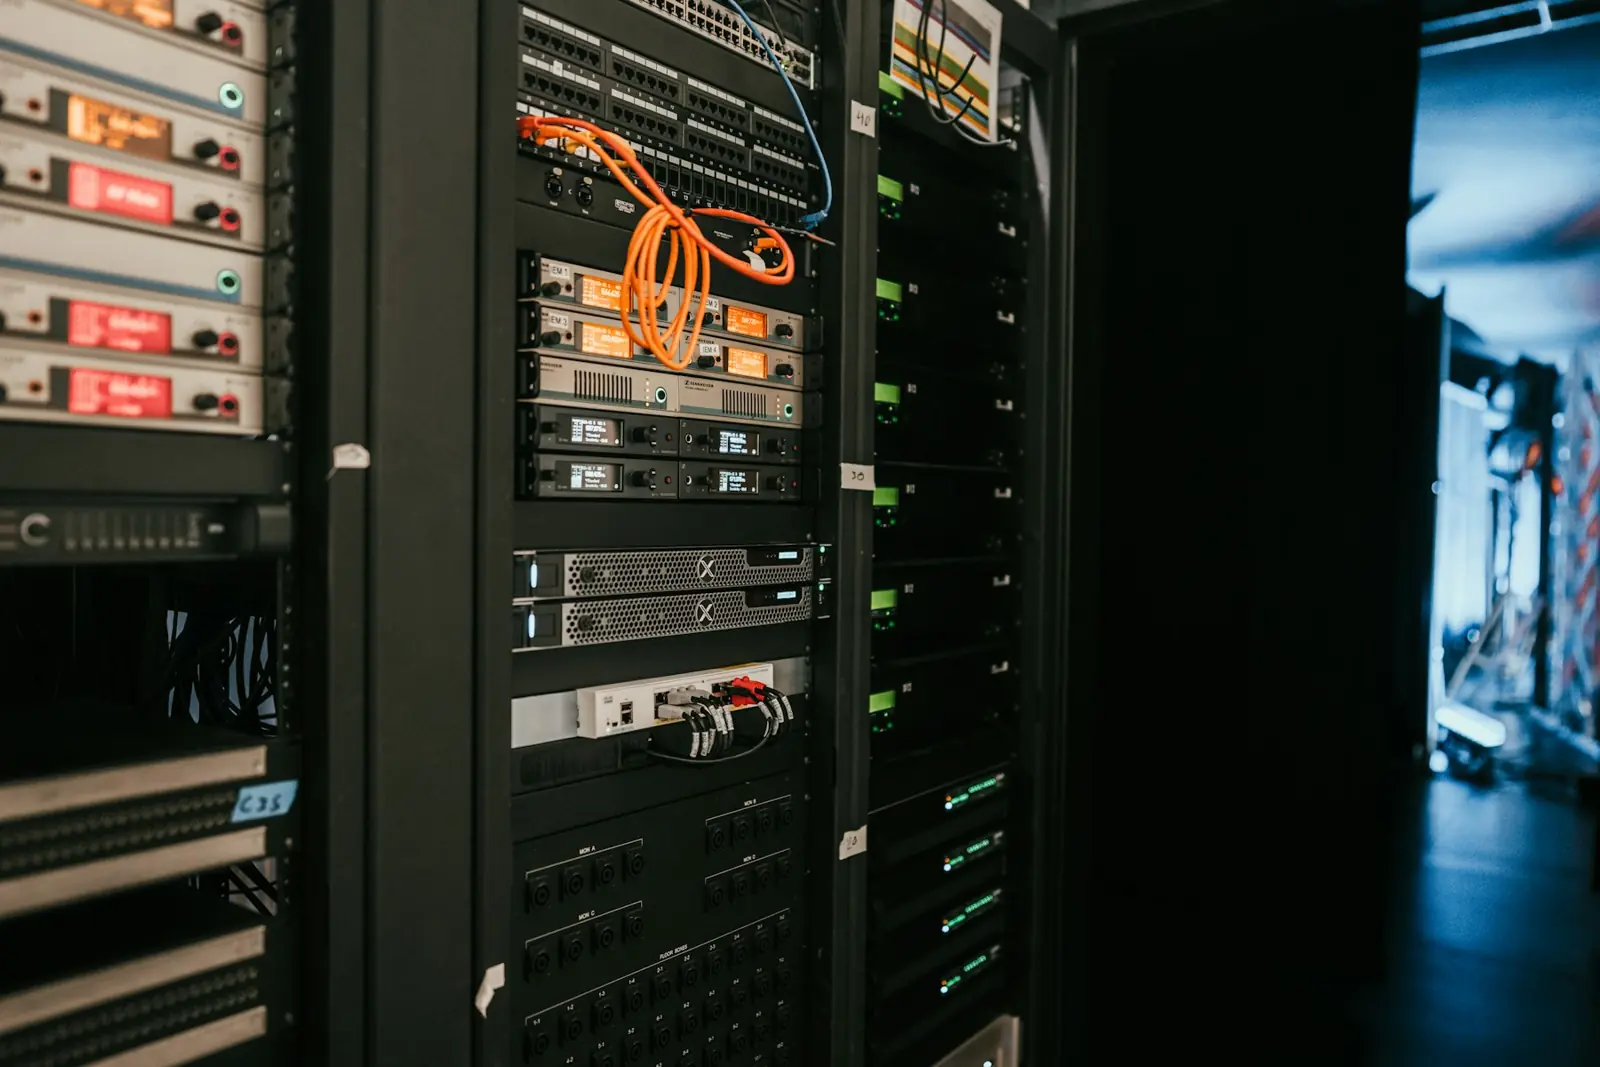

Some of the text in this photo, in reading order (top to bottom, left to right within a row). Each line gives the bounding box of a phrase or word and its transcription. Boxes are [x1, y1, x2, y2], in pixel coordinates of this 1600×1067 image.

[856, 110, 870, 126] 40
[852, 470, 864, 481] 30
[578, 847, 590, 855] MON
[578, 912, 590, 920] MON
[660, 950, 674, 960] FLOOR
